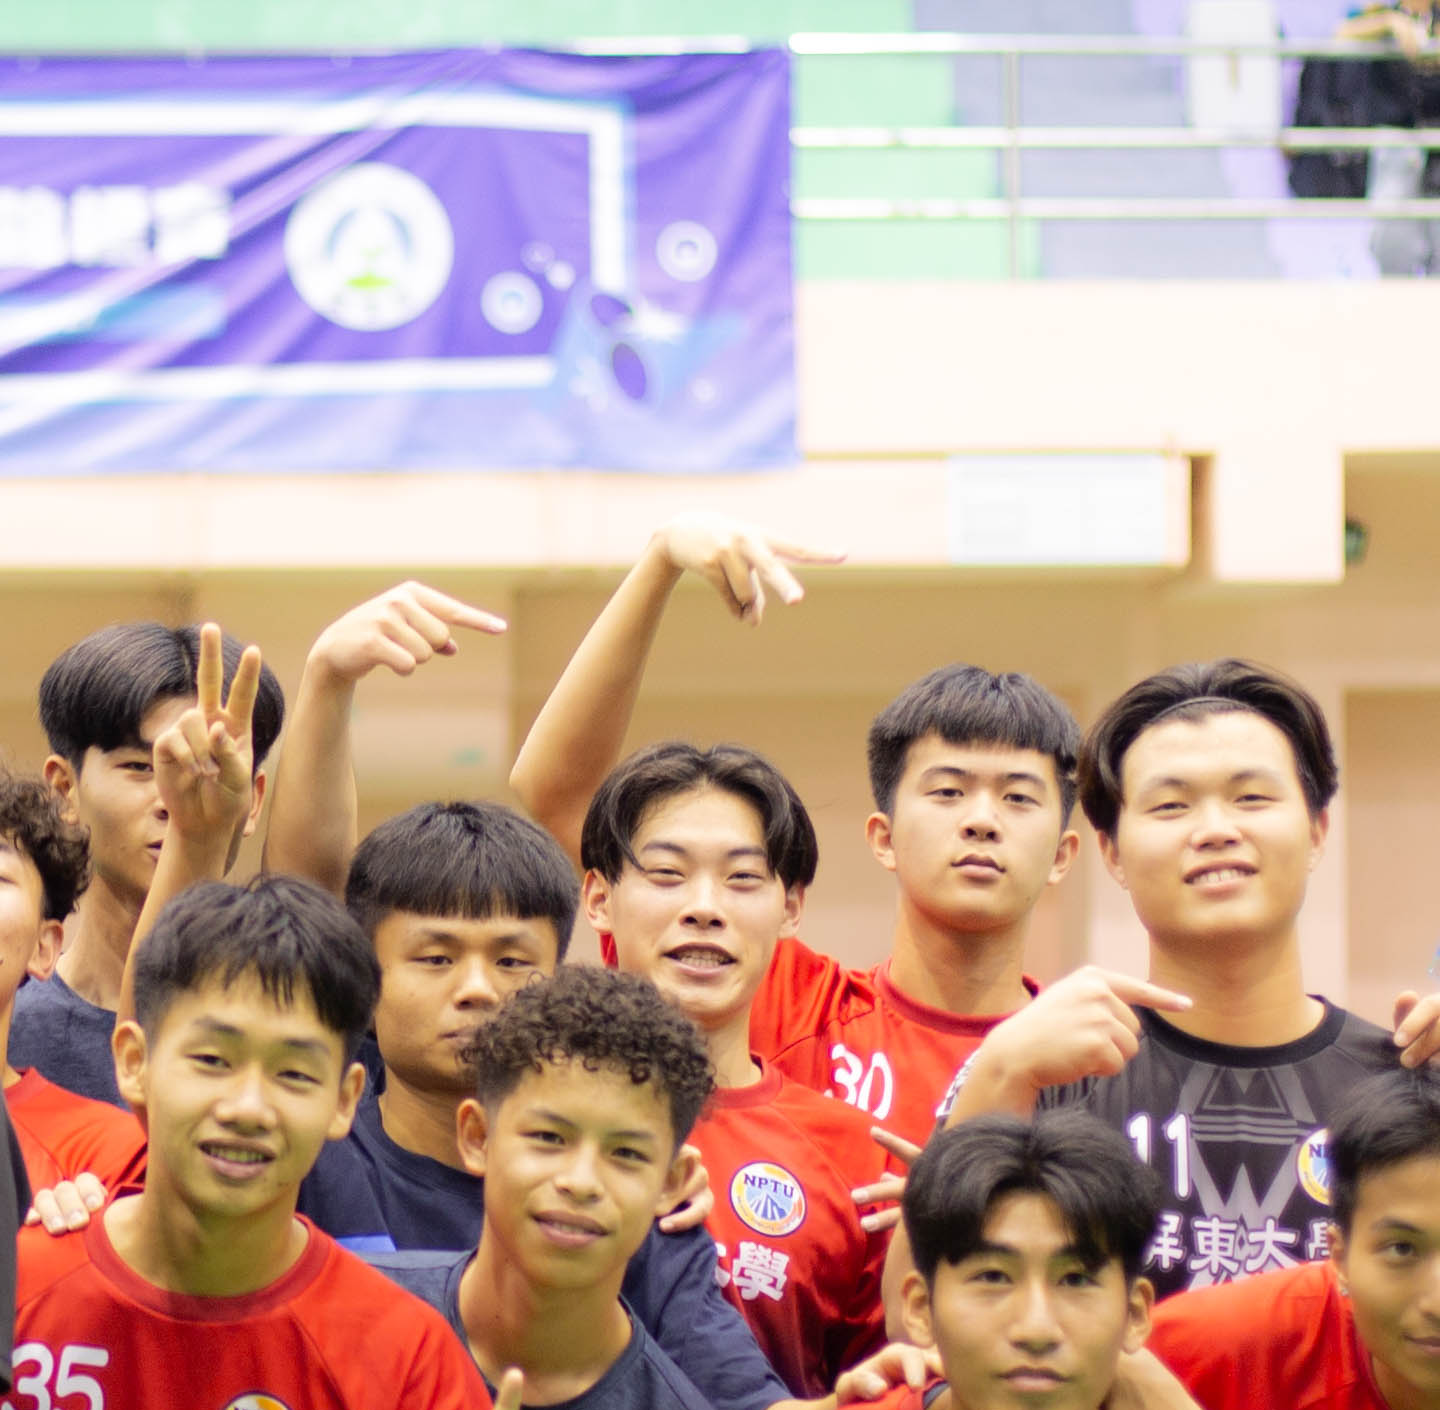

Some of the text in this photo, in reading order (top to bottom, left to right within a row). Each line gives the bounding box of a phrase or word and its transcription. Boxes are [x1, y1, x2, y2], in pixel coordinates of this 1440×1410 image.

[826, 1043, 893, 1120] 30
[743, 1173, 795, 1199] NPTU
[1129, 1112, 1192, 1199] 11
